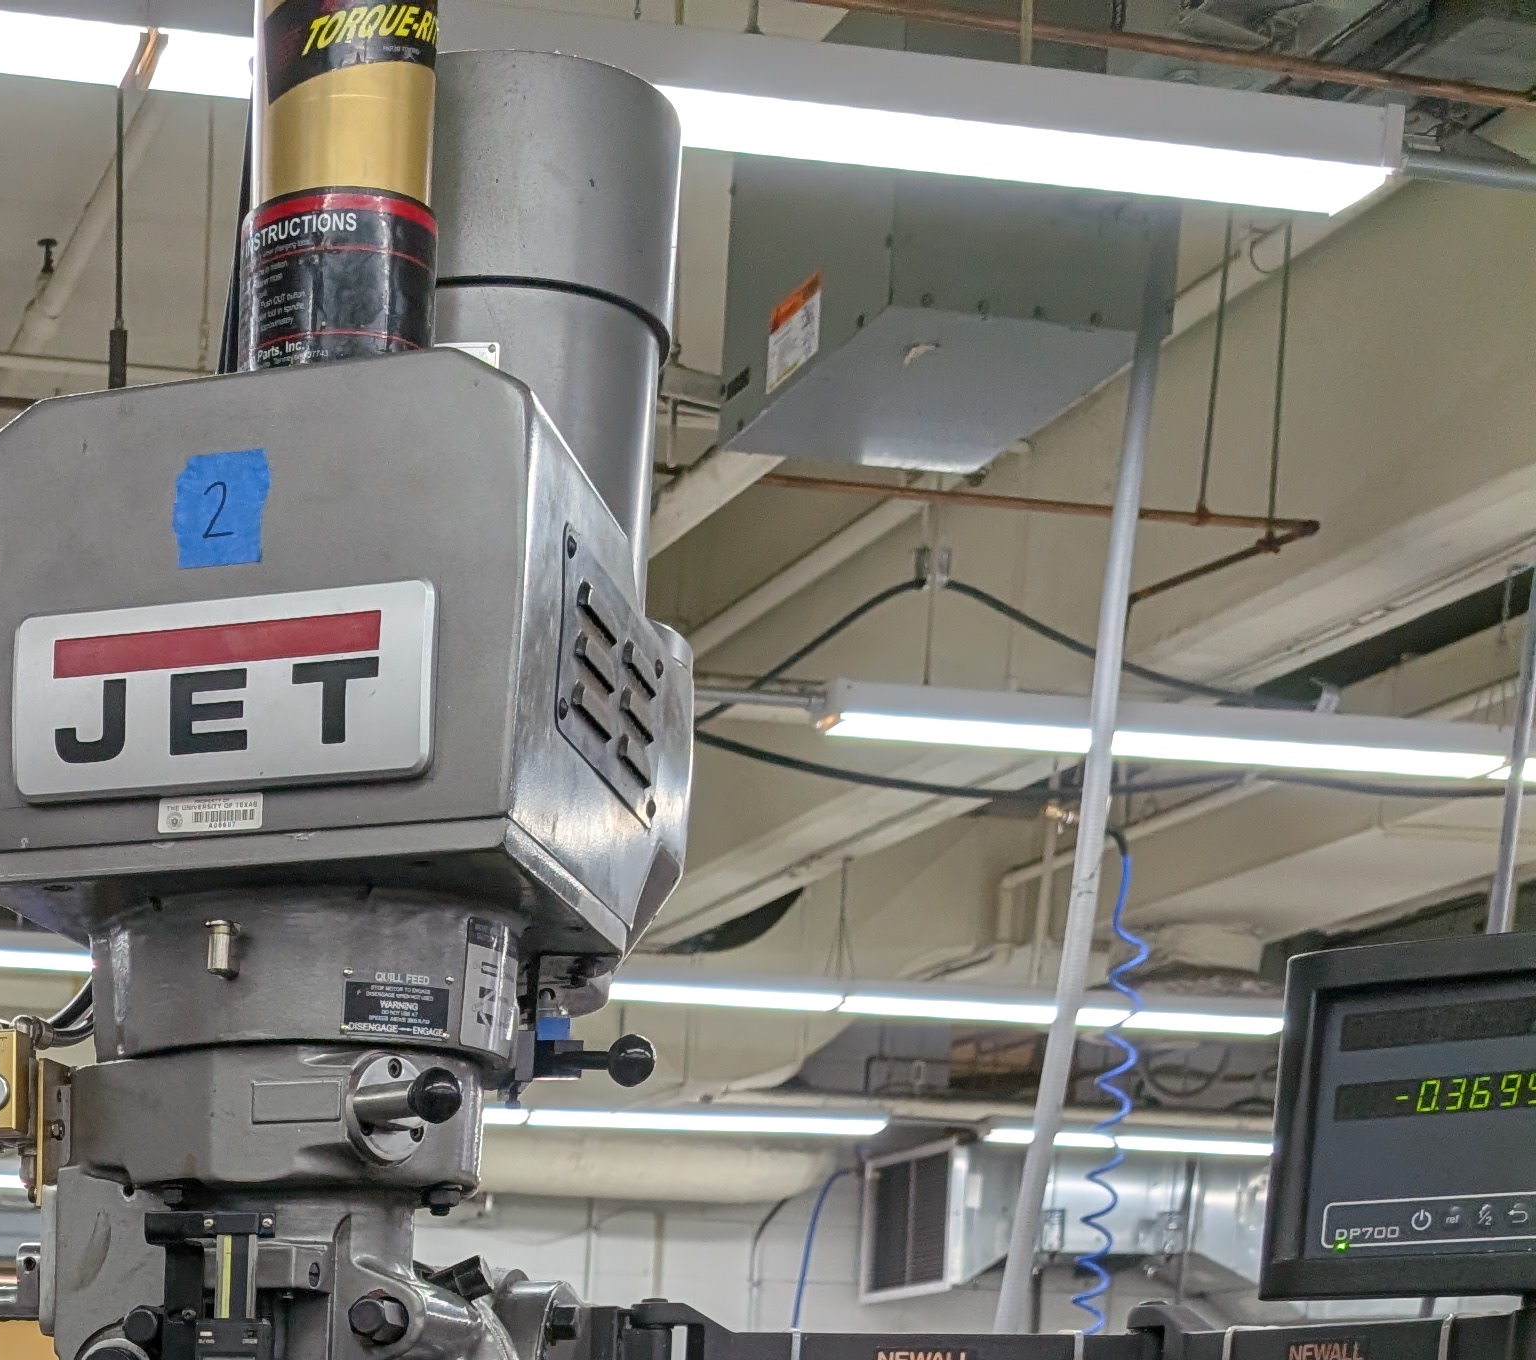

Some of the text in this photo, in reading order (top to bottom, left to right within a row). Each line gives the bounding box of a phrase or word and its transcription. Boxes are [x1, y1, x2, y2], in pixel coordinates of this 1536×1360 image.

[257, 345, 283, 362] Parts,
[285, 341, 305, 353] Inc.
[202, 480, 235, 539] 2
[54, 656, 380, 764] JET
[181, 803, 222, 811] UNIVERSITY
[375, 971, 430, 985] QUILL FEED
[380, 1000, 418, 1011] WARNING
[349, 1022, 443, 1036] DISENGAGE ENGAGE
[1335, 1226, 1400, 1241] DP700
[1446, 1213, 1461, 1224] ref
